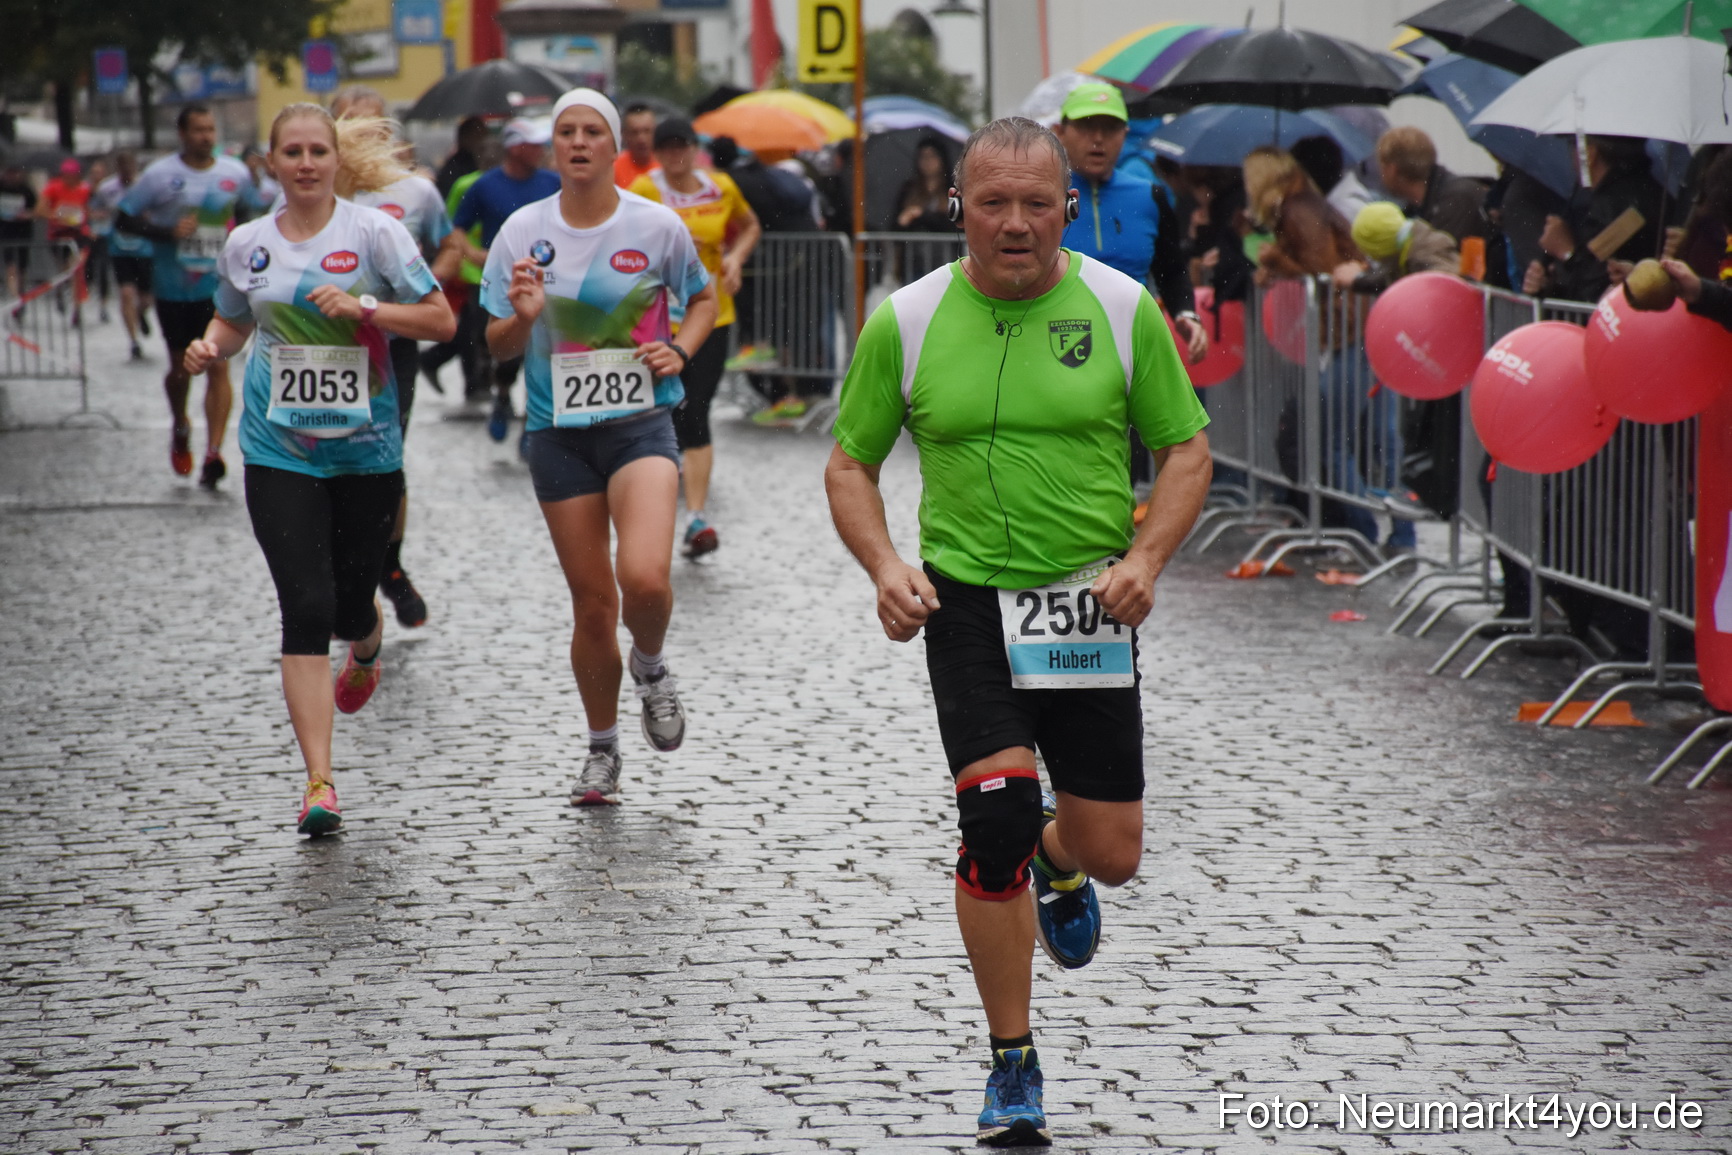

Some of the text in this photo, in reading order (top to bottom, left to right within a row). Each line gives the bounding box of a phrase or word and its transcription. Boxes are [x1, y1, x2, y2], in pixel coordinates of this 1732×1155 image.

[816, 5, 845, 54] D
[325, 256, 356, 269] Hervis
[614, 255, 645, 268] Hervis
[1060, 334, 1070, 350] F
[1074, 345, 1086, 361] C
[280, 368, 359, 403] 2053
[564, 371, 644, 409] 2282
[289, 412, 348, 426] Christina
[1048, 650, 1102, 669] Hubert
